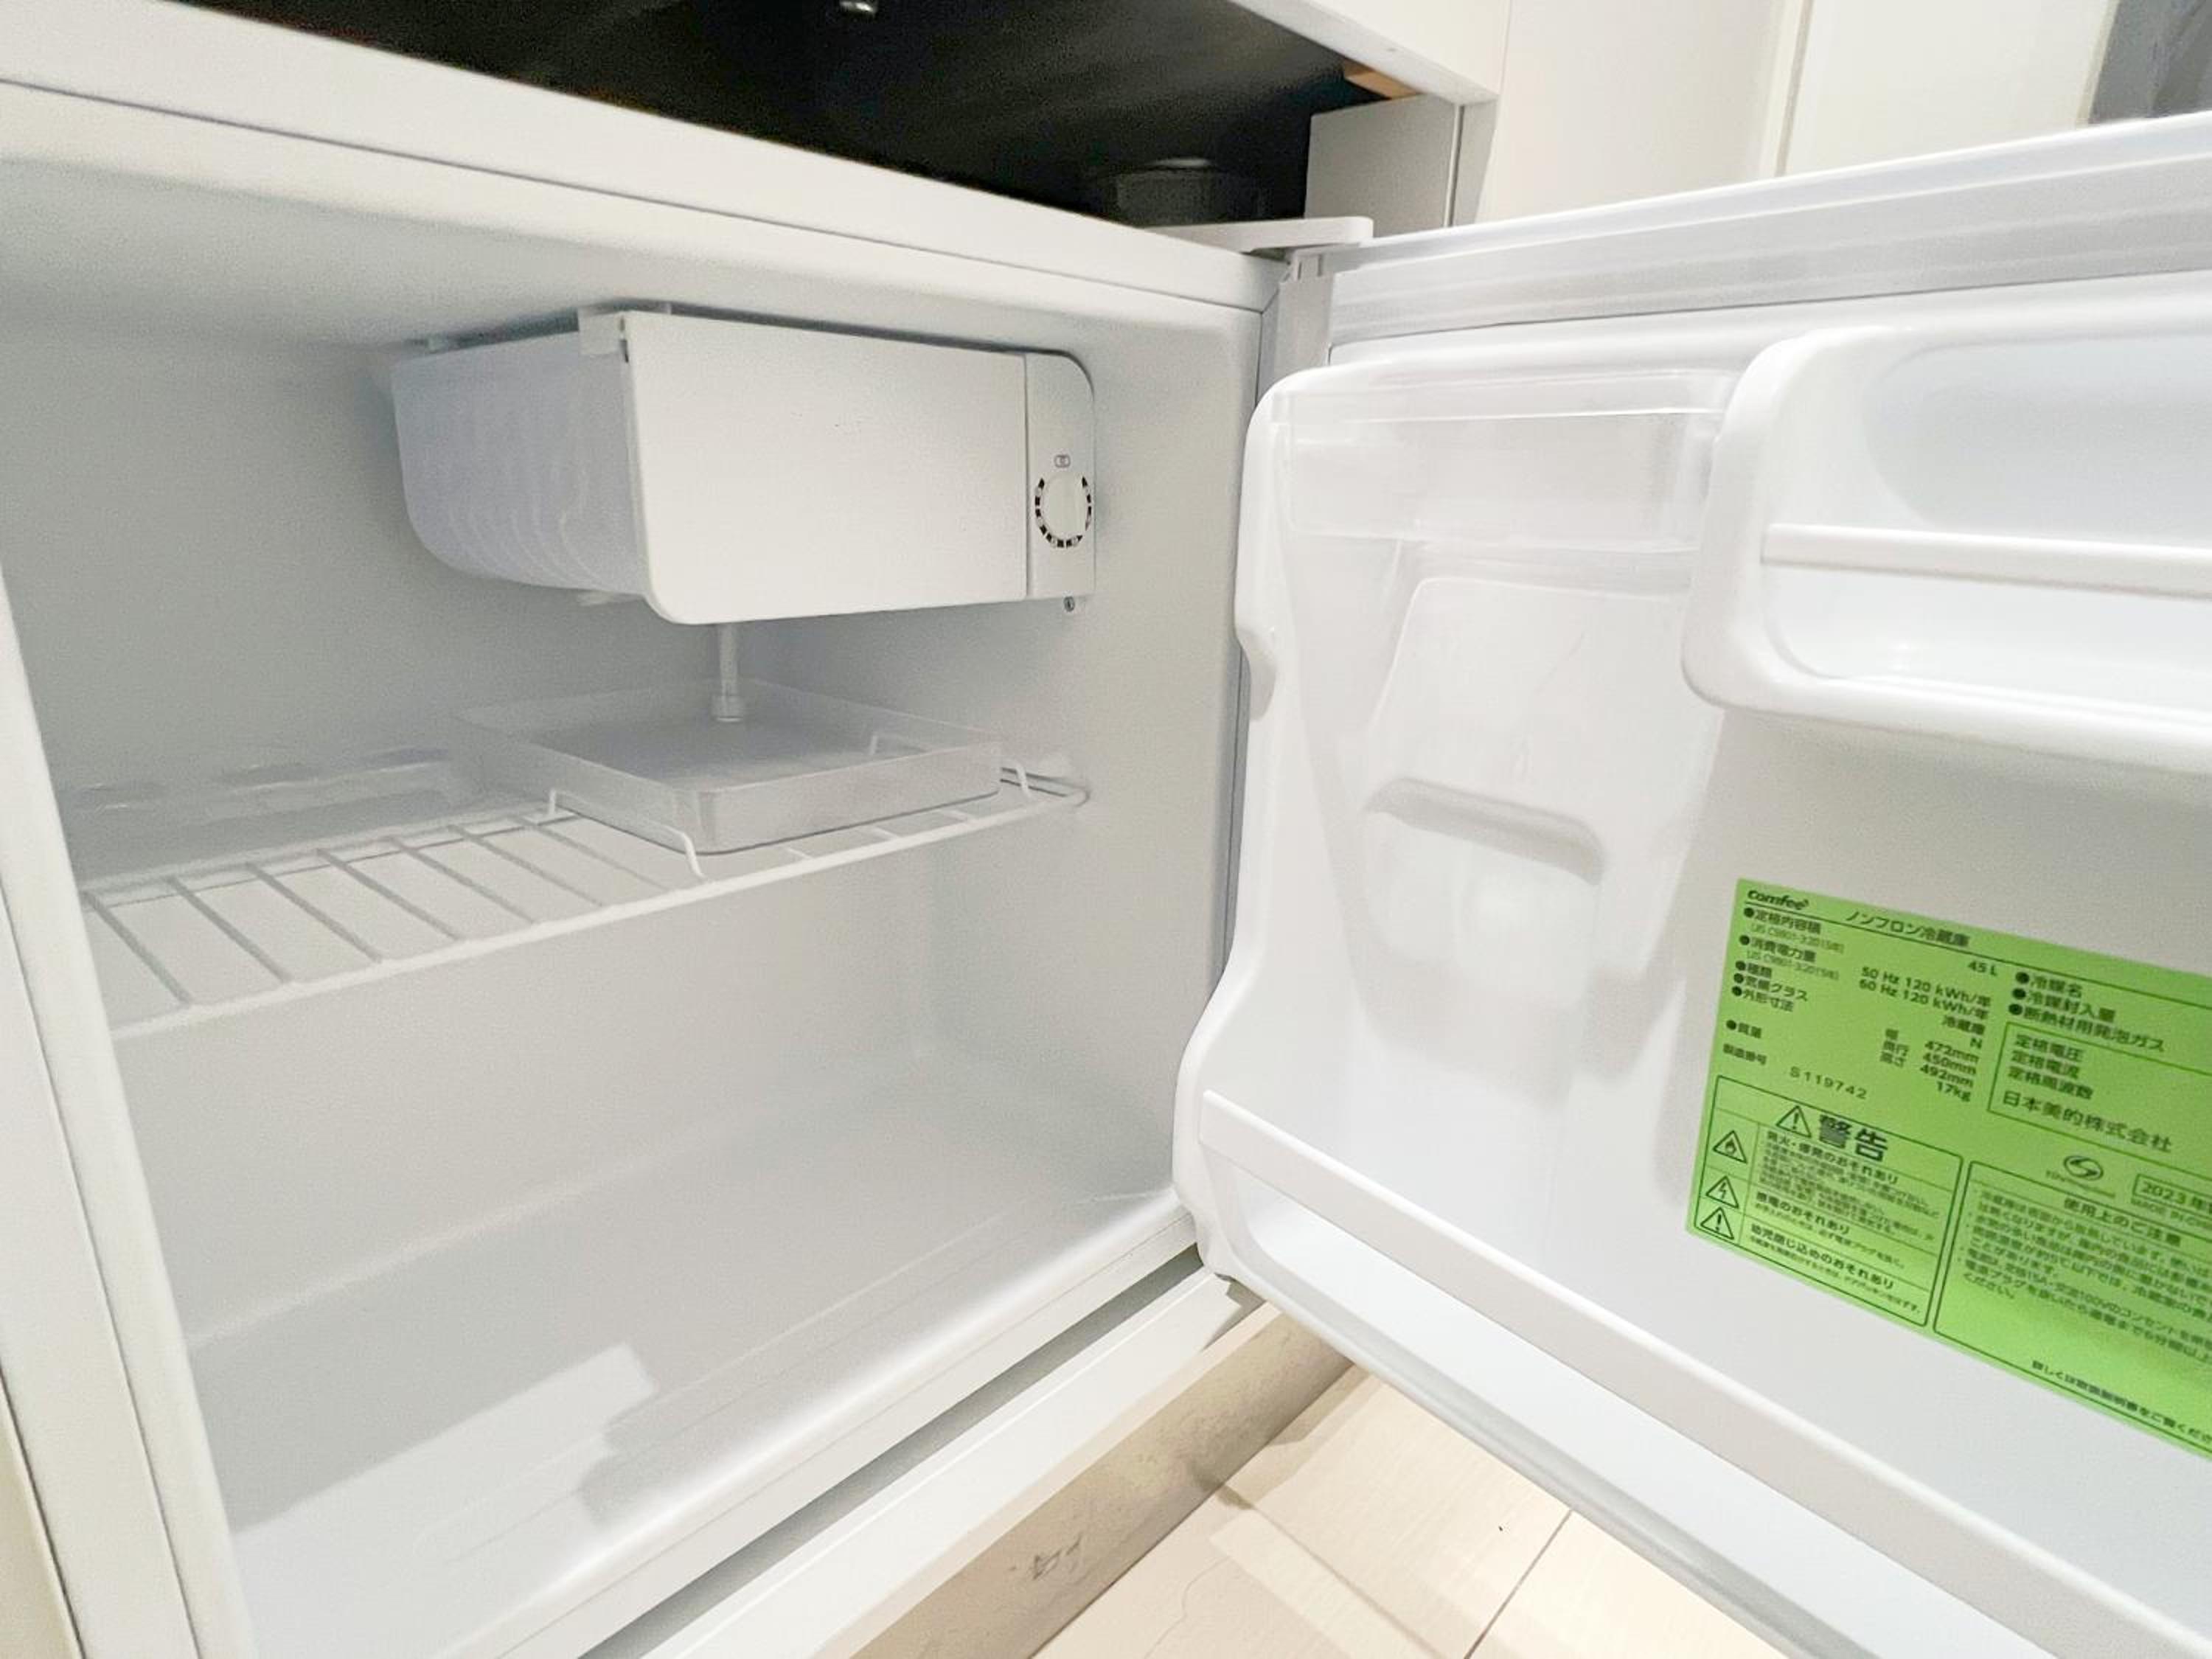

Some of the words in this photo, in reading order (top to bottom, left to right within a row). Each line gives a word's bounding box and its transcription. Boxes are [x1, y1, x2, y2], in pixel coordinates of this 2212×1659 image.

[1846, 911, 1970, 947] ノンフロン冷蔵庫
[1862, 967, 1879, 979] 50
[1883, 971, 1899, 984] Hz
[1906, 977, 1931, 992] 120
[1968, 961, 1986, 973] 45
[1859, 979, 1877, 991] 60
[1881, 984, 1897, 996] Hz
[1904, 990, 1928, 1004] 120
[1924, 1040, 1980, 1064] 472mm
[1970, 1037, 1982, 1048] N
[2015, 1034, 2083, 1062] 定格電圧
[1920, 1064, 1973, 1088] 492mm
[1923, 1052, 1976, 1076] 450mm
[2011, 1050, 2080, 1079] 定格電流
[1790, 1066, 1867, 1100] S119742
[1937, 1081, 1970, 1102] 17kg
[2003, 1091, 2172, 1153] 日本美的株式会社
[1819, 1114, 1888, 1162] 警告
[2065, 1197, 2180, 1247] 使用上のご注意
